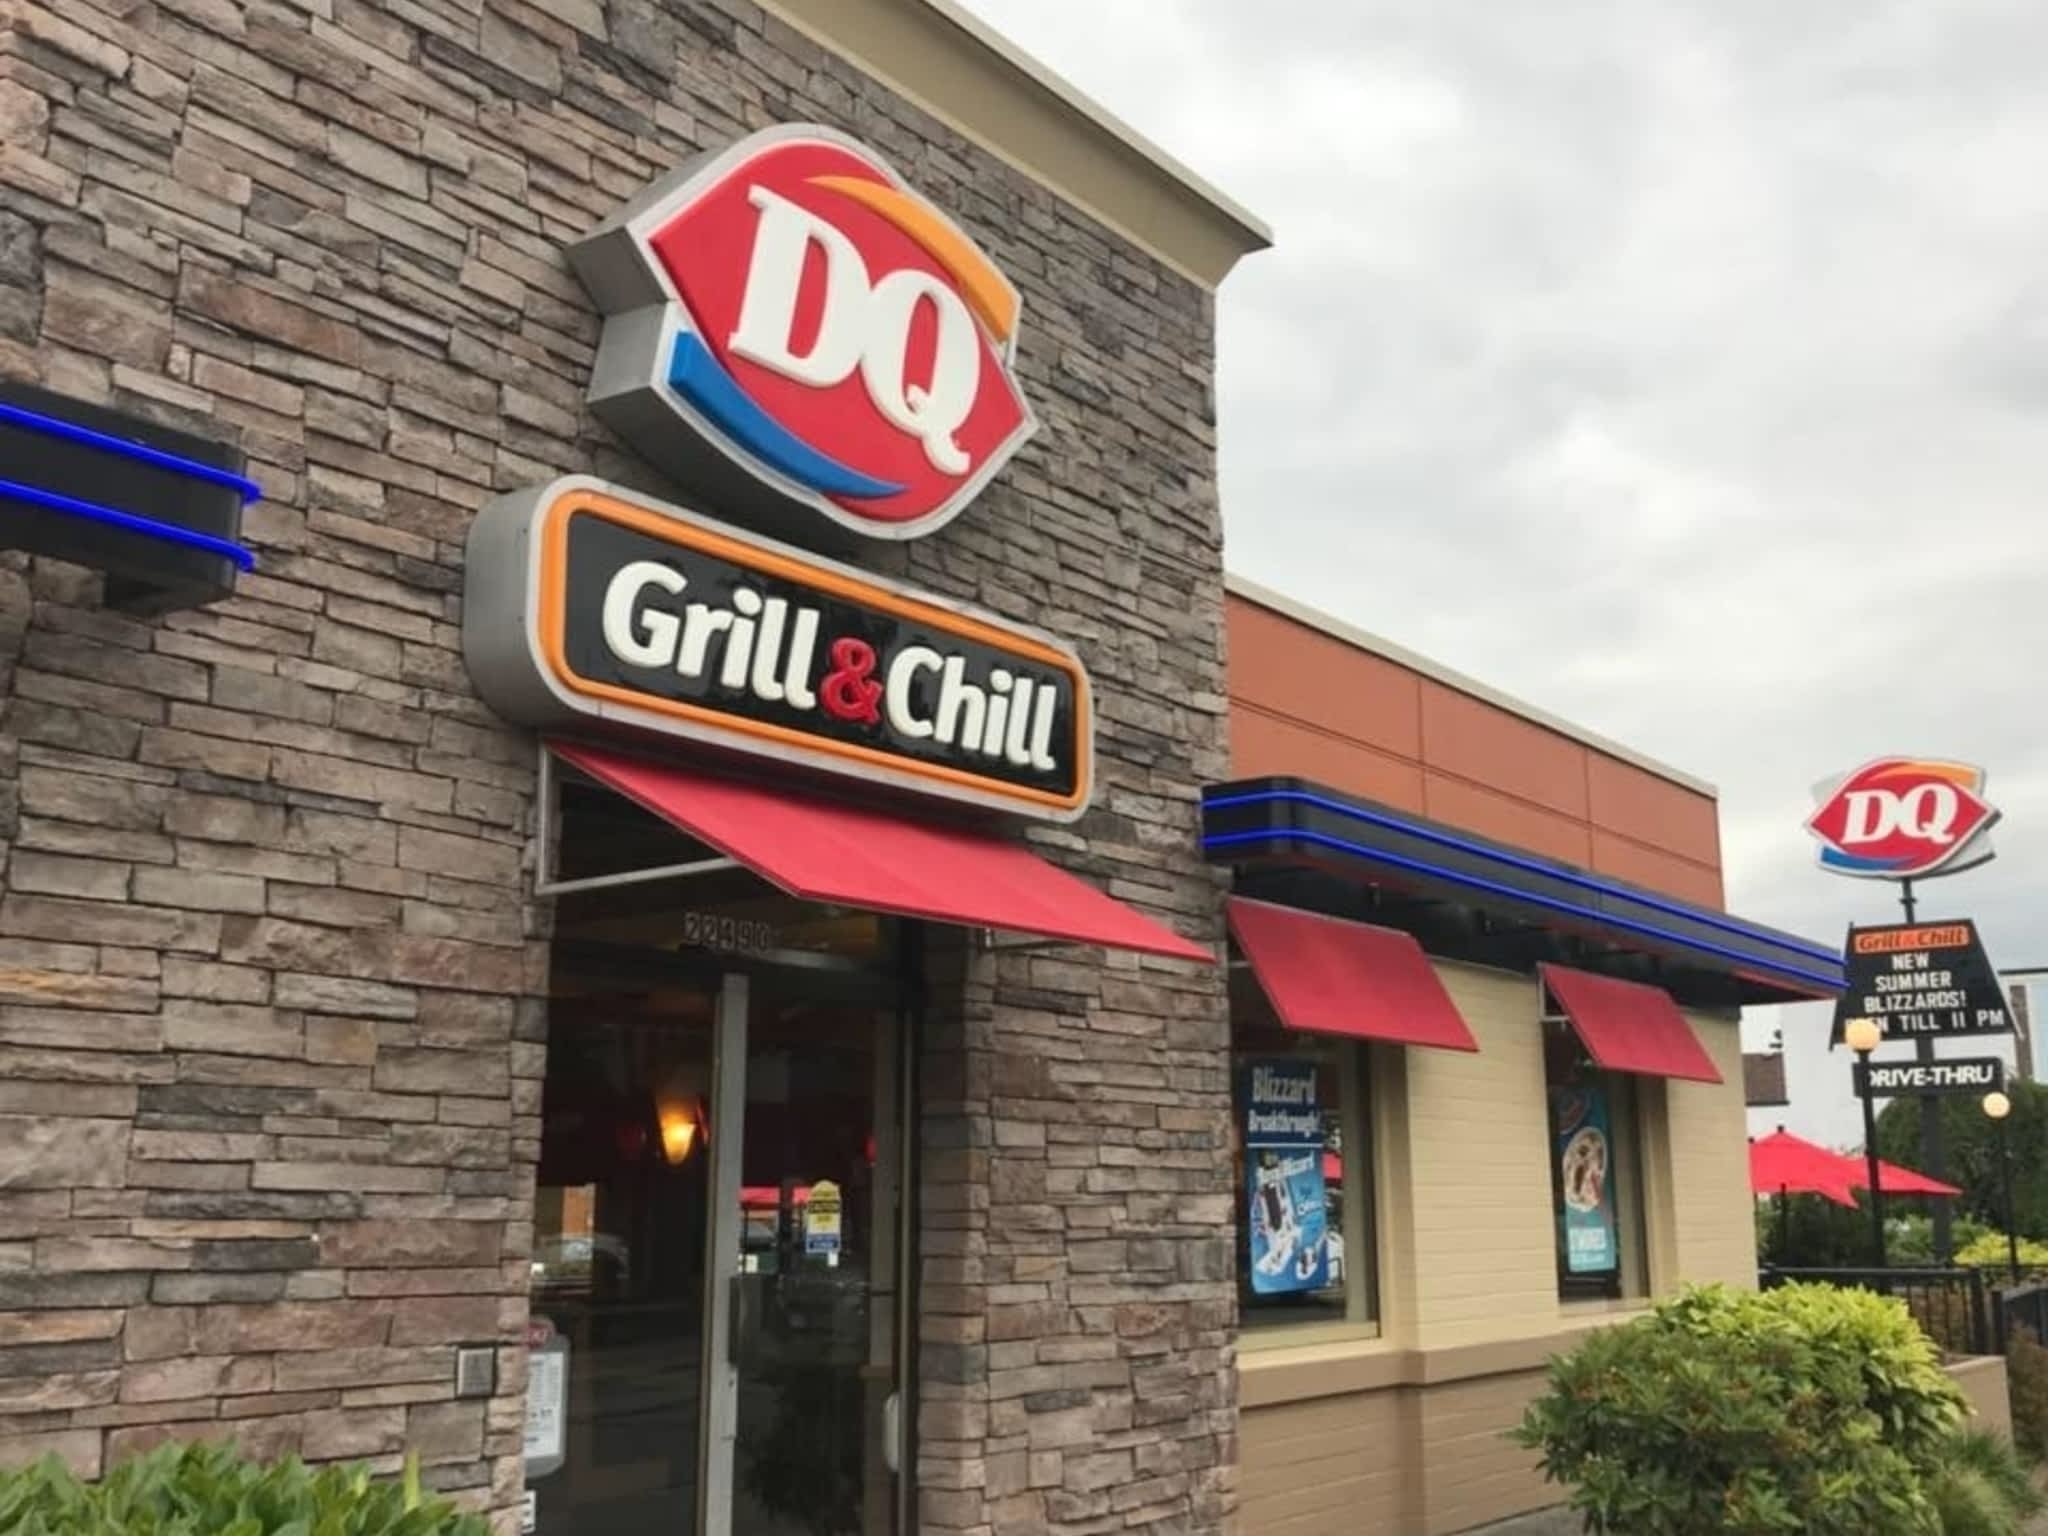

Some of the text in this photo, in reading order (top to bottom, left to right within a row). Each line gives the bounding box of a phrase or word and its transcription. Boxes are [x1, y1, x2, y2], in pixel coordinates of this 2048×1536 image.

[729, 184, 981, 475] DQ
[602, 561, 820, 710] Grill
[886, 645, 1057, 771] Chill
[1840, 783, 1959, 844] DQ
[1891, 952, 1930, 970] NEW
[1874, 970, 1953, 993] SUMMER
[1863, 989, 1967, 1013] BLIZZARDS!
[1898, 1012, 1941, 1033] TILL
[1976, 1009, 2005, 1028] PM
